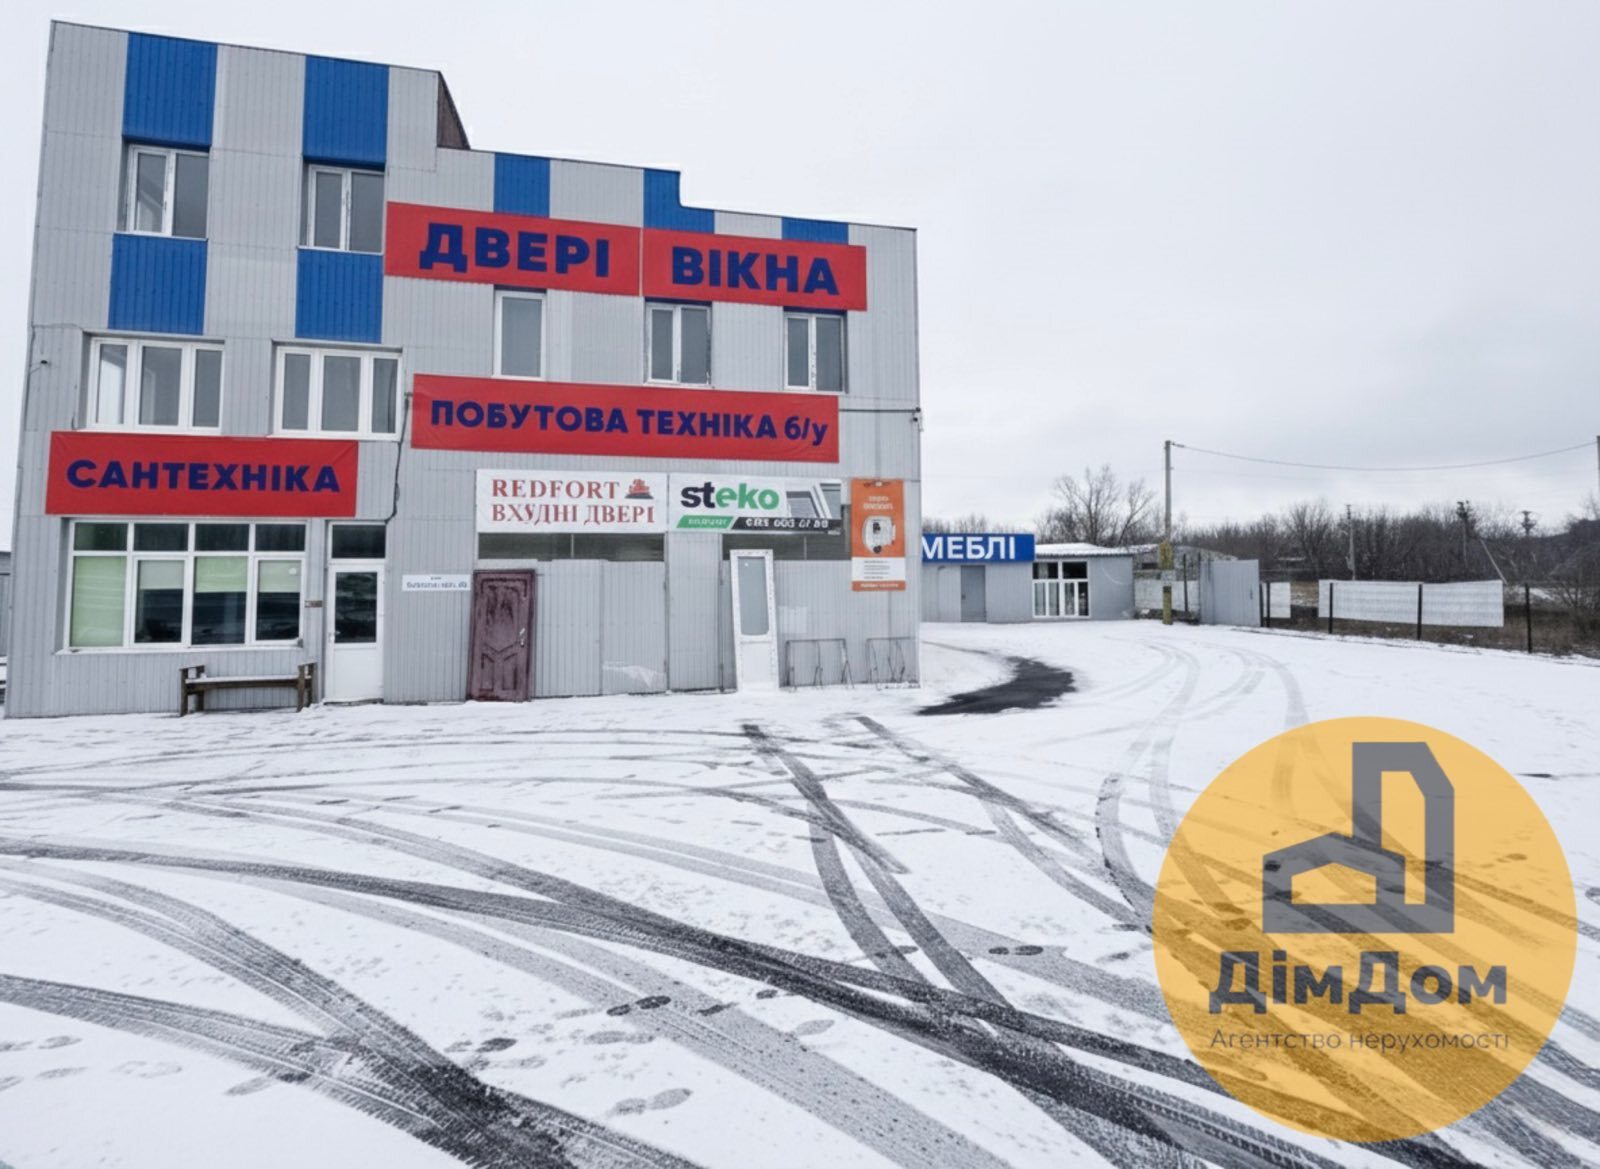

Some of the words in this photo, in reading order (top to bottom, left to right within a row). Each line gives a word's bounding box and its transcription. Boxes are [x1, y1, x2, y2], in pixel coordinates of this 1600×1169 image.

[419, 222, 610, 278] ДВЕРІ
[672, 246, 839, 296] ВІКНА
[431, 400, 628, 434] ПОБУТОВА
[637, 409, 776, 439] ТЕХНІКА
[784, 415, 828, 447] б/у
[67, 459, 339, 491] САНТЕХНІКА
[491, 478, 620, 499] REDFORT
[680, 481, 780, 510] steko
[491, 503, 578, 526] ВХУДНІ
[583, 505, 655, 526] ДВЕРІ
[921, 536, 1016, 559] МЕБЛІ
